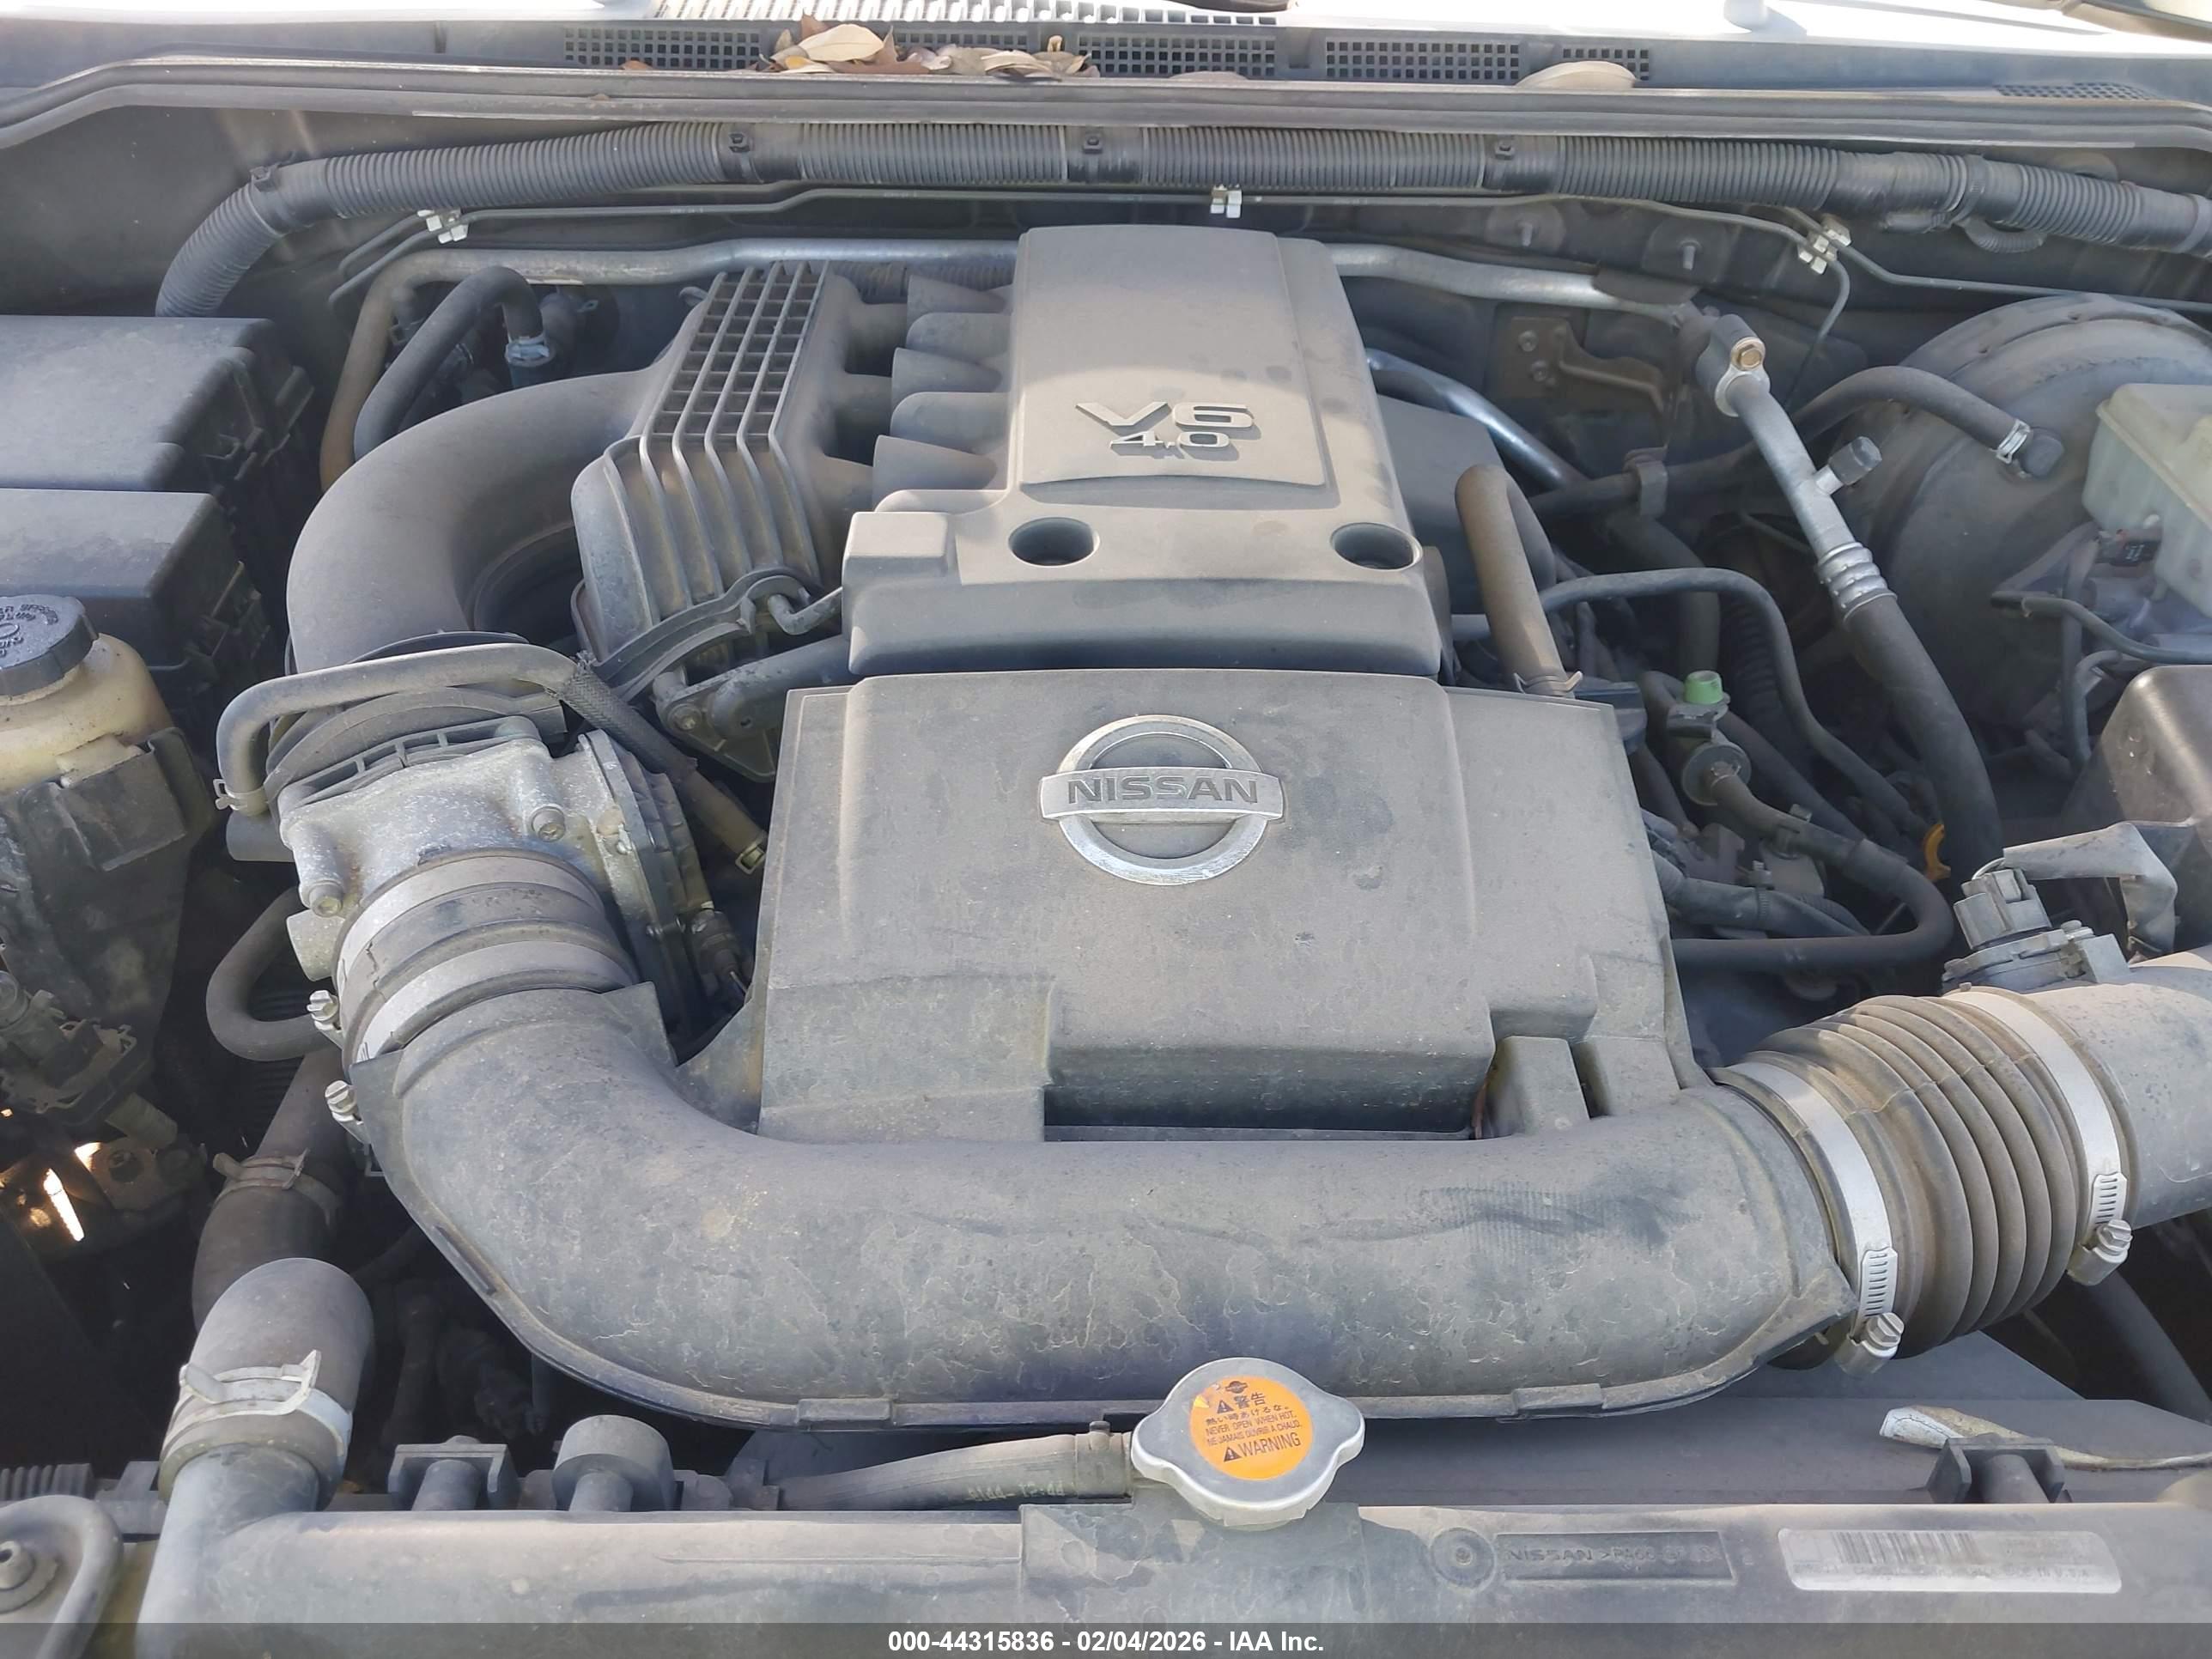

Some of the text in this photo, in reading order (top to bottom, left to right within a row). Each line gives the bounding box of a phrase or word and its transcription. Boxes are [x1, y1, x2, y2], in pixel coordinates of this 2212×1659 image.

[1076, 402, 1255, 428] V6
[1110, 431, 1230, 449] 4.0
[1068, 775, 1258, 804] NISSAN
[1234, 1392, 1266, 1409] 警告
[1206, 1424, 1230, 1436] NEVER
[1233, 1419, 1252, 1430] OPEN
[1255, 1415, 1278, 1425] WHEN
[1237, 1432, 1301, 1457] WARNING
[1507, 1546, 1593, 1560] NISSAN
